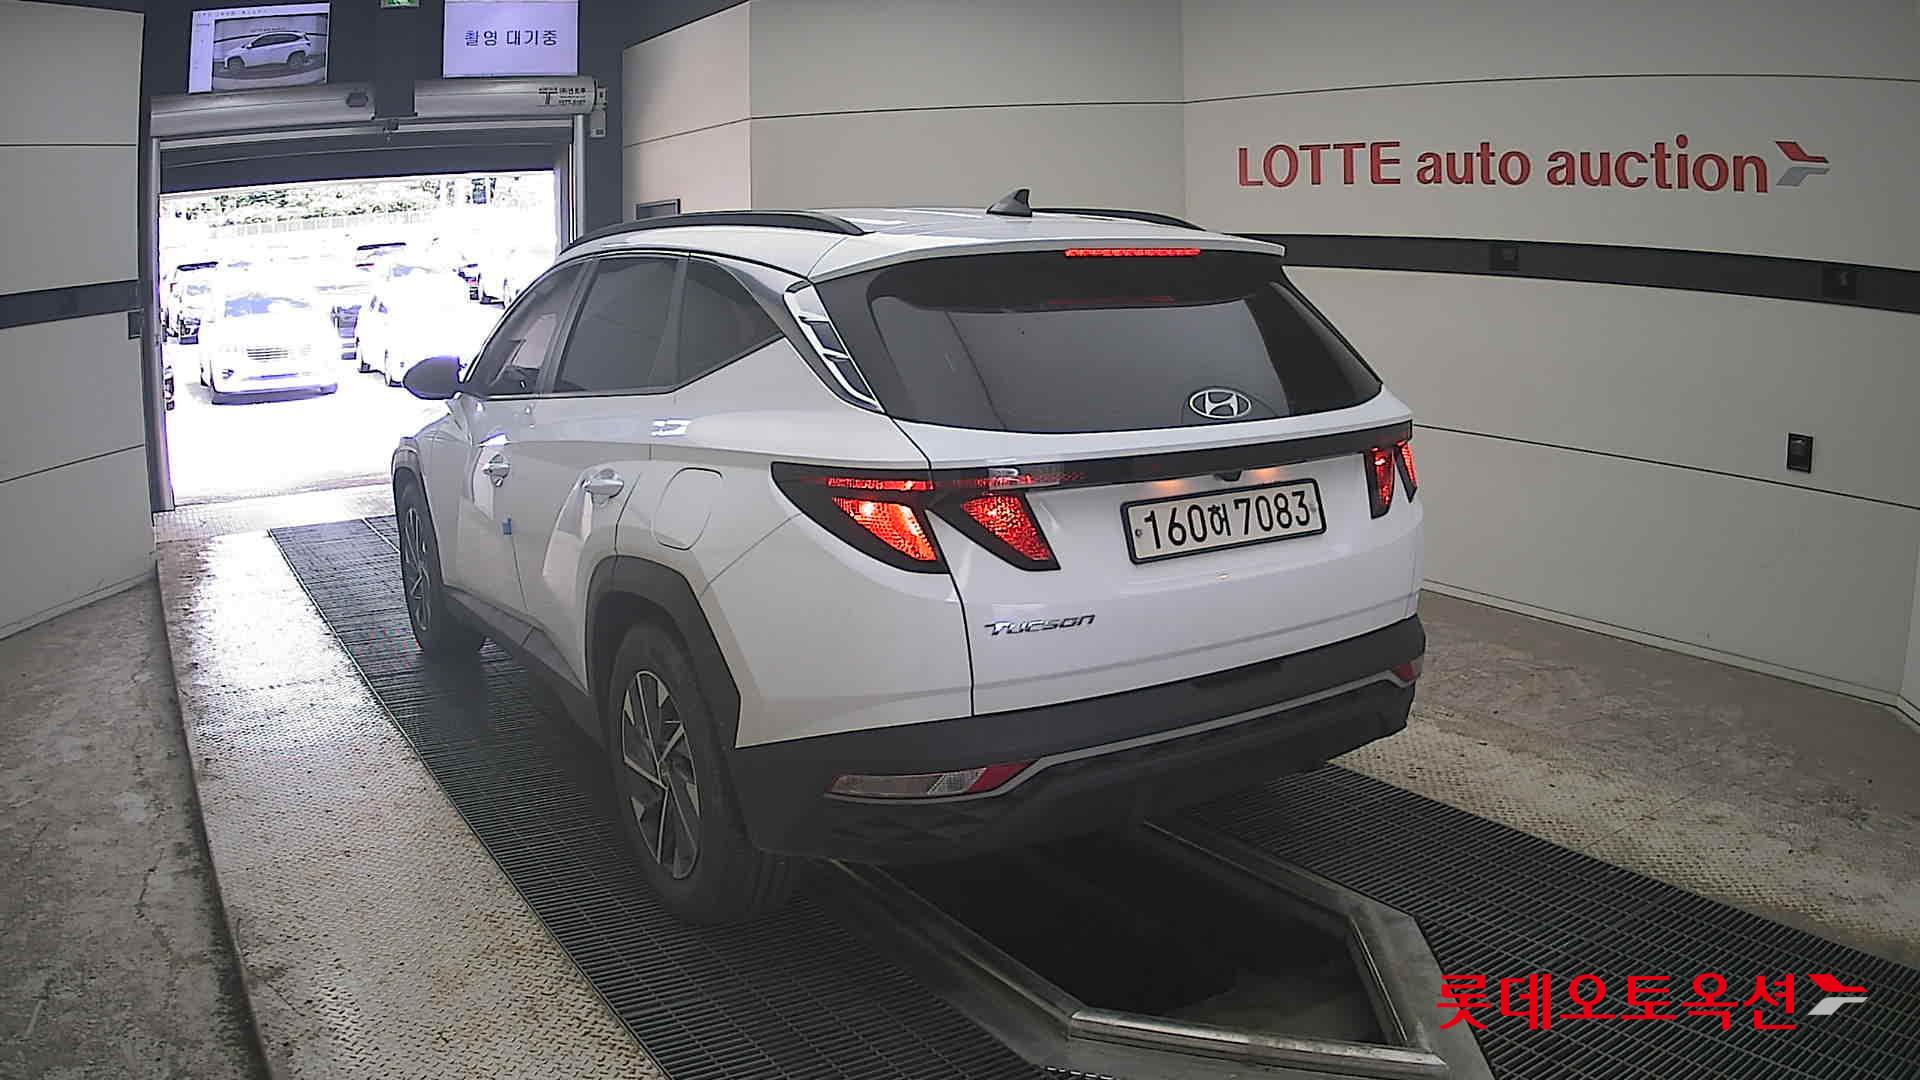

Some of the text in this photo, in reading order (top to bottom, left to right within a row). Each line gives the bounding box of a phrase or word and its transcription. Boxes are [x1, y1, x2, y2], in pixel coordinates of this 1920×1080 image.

[505, 29, 558, 47] 대기중
[1237, 135, 1769, 194] LOTTE auto auction
